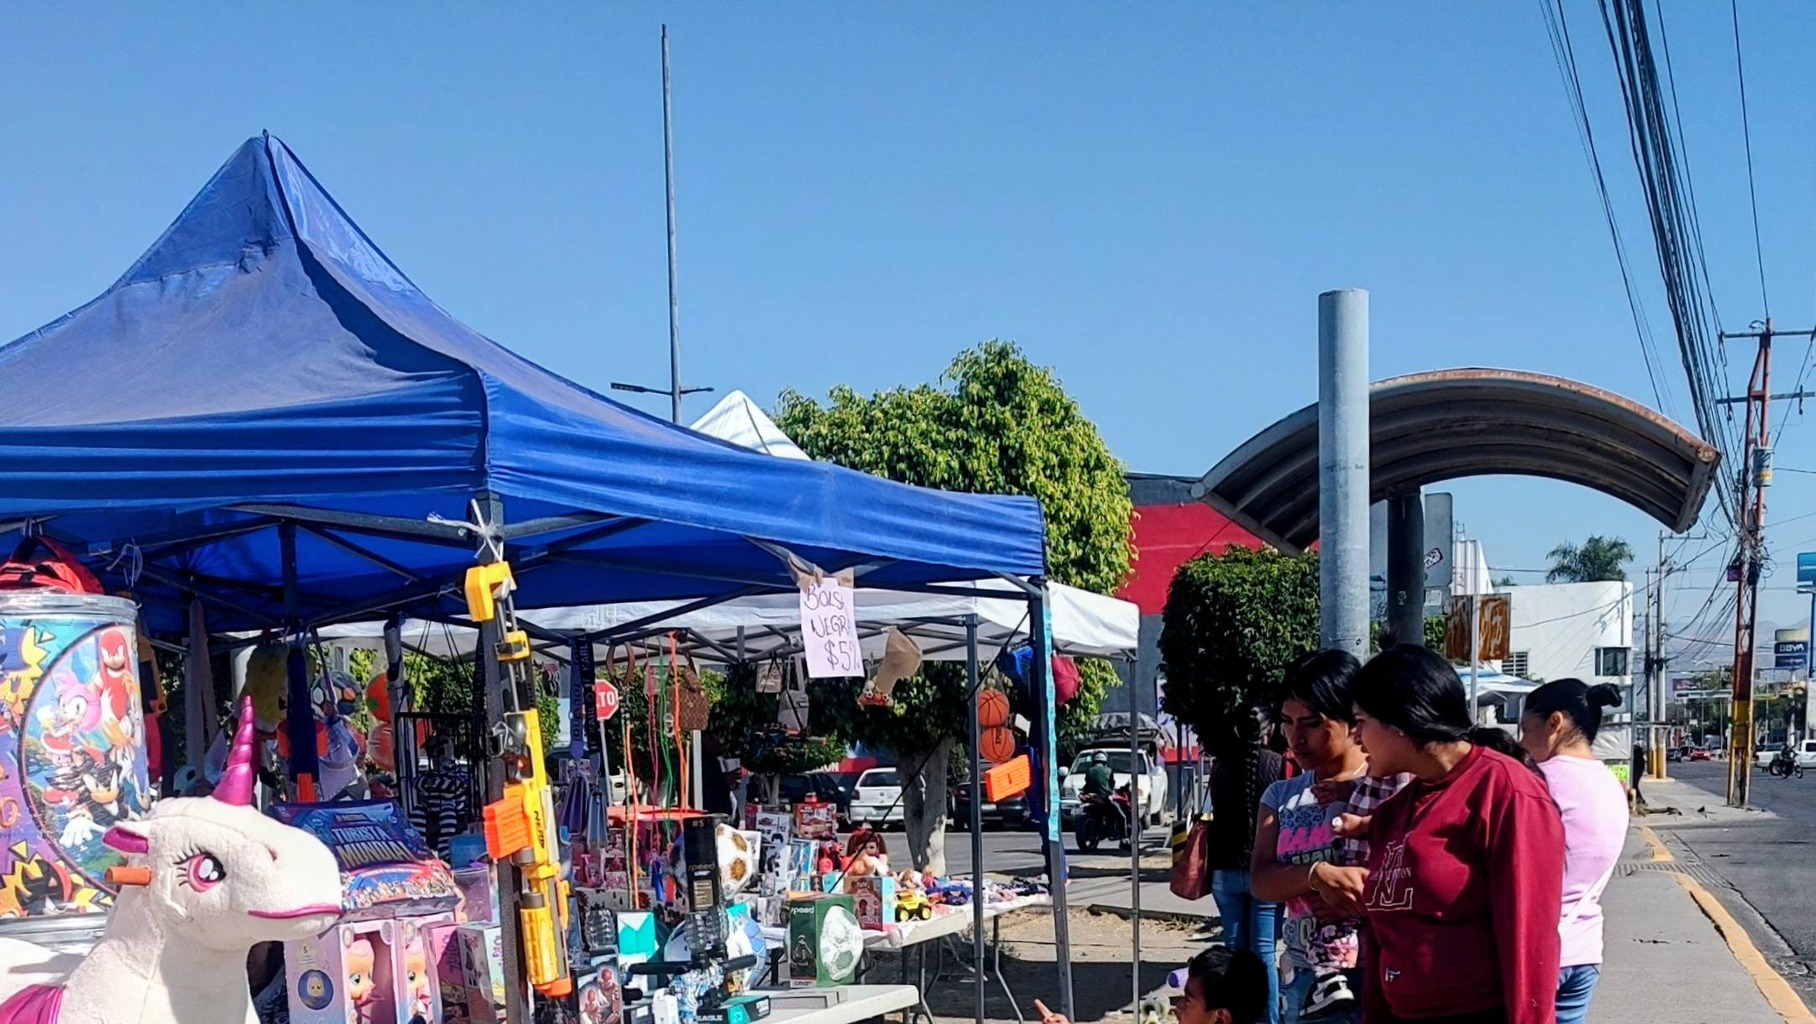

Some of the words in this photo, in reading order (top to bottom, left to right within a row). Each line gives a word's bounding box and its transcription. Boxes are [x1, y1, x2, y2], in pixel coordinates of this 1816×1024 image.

[803, 582, 845, 611] BOLS
[599, 691, 616, 708] TO
[331, 825, 392, 844] TURISTA
